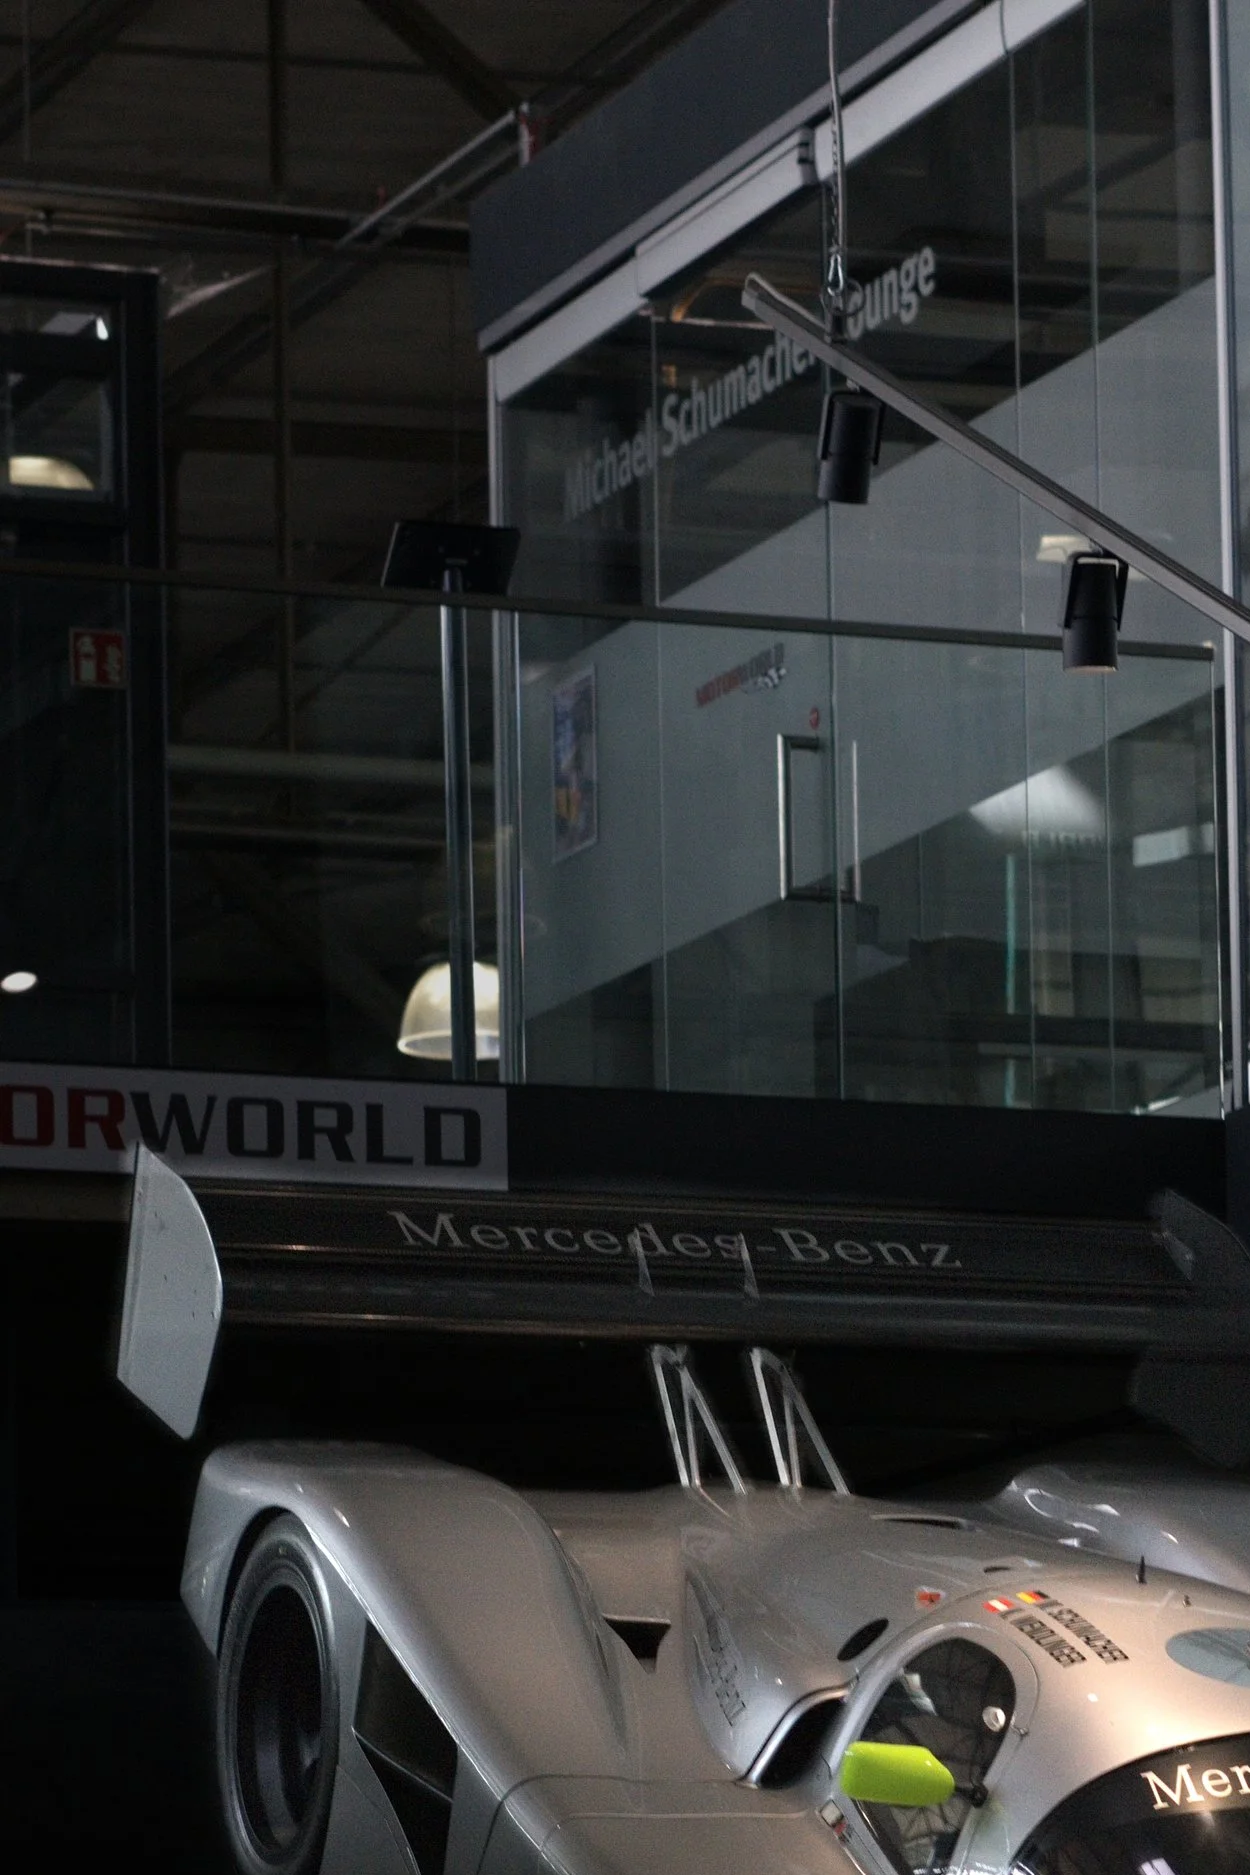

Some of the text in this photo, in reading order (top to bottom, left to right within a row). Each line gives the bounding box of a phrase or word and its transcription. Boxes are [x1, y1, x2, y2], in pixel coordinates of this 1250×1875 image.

[563, 407, 656, 522] Michael
[845, 245, 937, 342] ounge
[0, 1084, 482, 1168] ORWORLD
[387, 1209, 962, 1269] Mercedes-Benz
